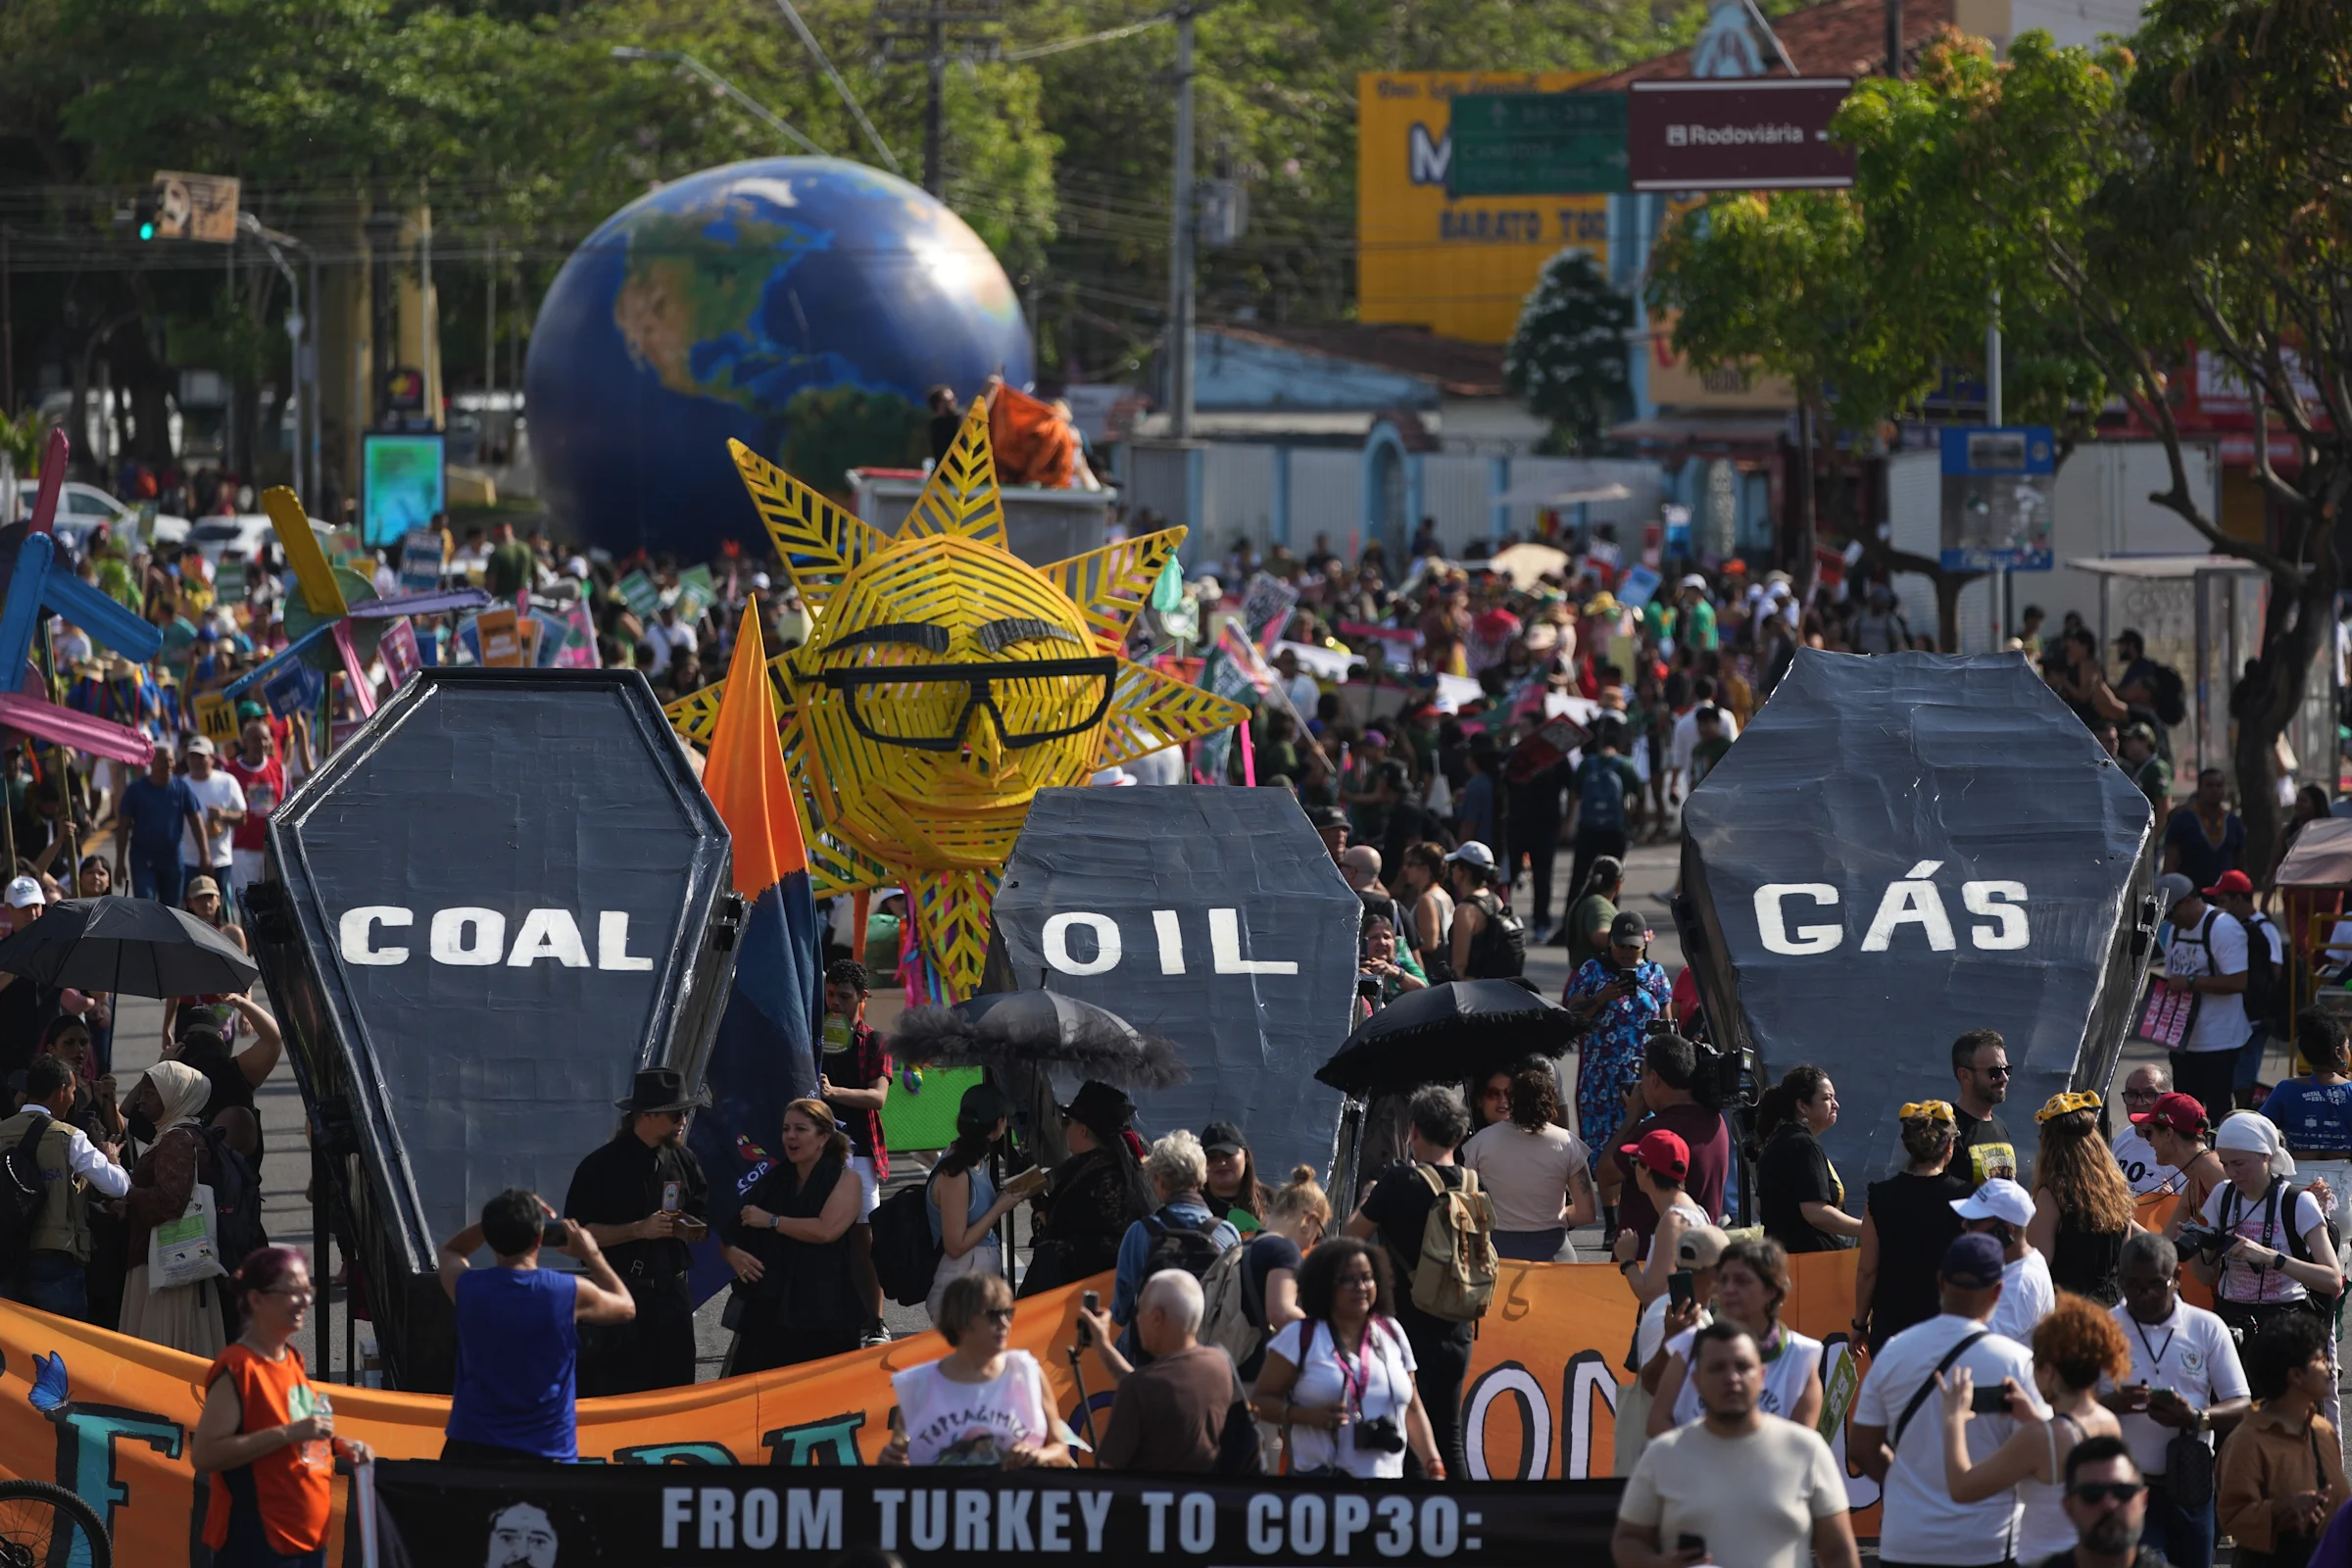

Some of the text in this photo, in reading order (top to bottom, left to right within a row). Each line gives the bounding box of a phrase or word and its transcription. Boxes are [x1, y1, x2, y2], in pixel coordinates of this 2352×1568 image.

[1690, 122, 1805, 145] Rodoviária
[206, 710, 231, 735] JÁ!
[339, 906, 655, 972] COAL
[1753, 860, 2031, 956] GÁS
[1042, 907, 1299, 976] OIL
[736, 1161, 769, 1190] COP
[662, 1486, 1482, 1558] FROM TURKEY TO COP30:
